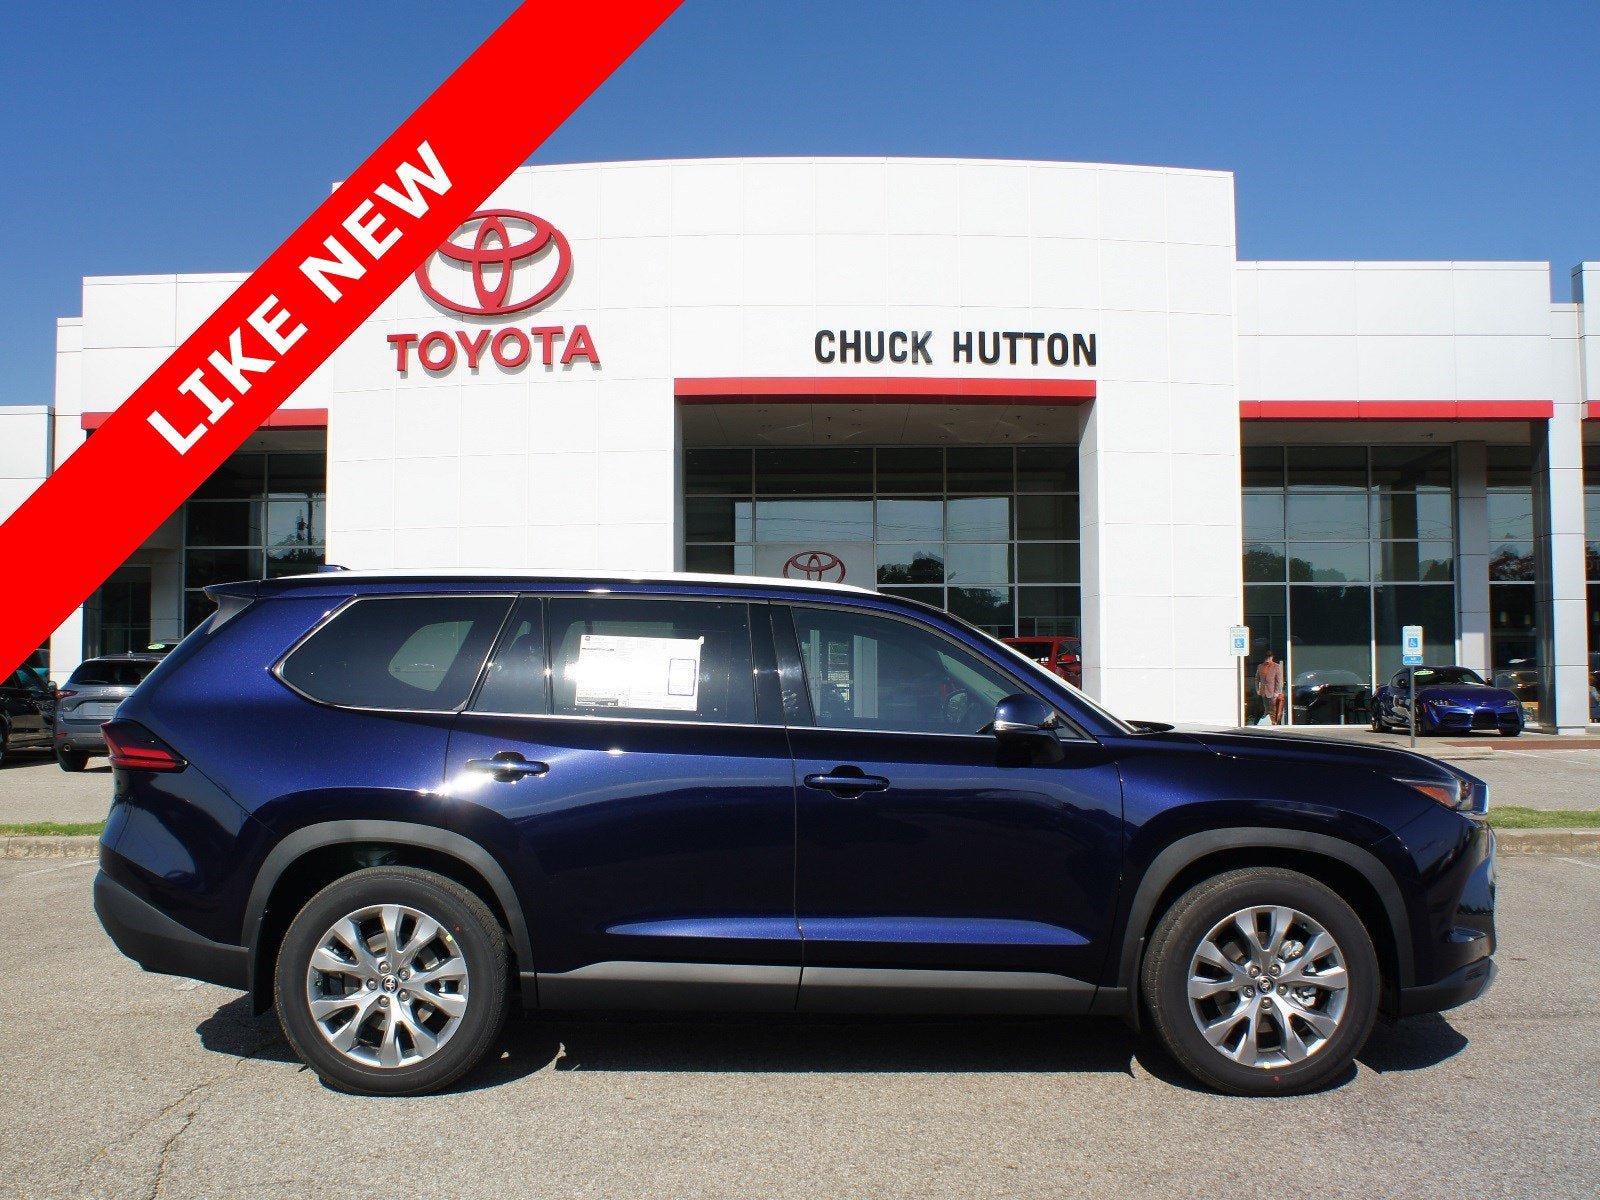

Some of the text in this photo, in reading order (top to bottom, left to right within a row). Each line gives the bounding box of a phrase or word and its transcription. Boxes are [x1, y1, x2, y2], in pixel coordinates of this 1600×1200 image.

[388, 325, 599, 372] TOYOTA
[815, 330, 1096, 366] CHUCK HUTTON
